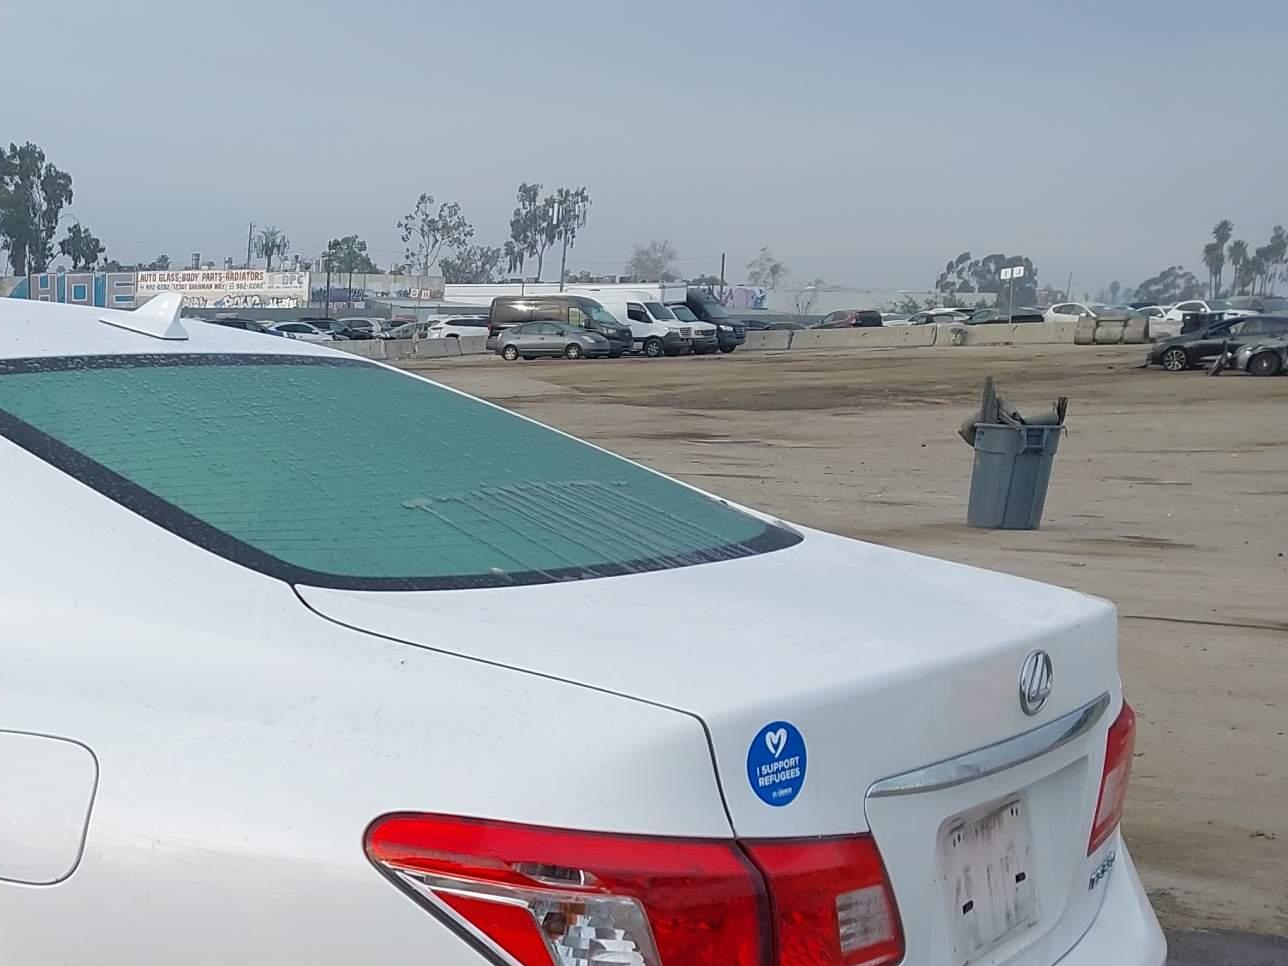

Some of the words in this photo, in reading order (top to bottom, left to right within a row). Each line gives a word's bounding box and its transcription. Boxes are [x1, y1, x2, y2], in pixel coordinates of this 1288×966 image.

[140, 272, 157, 282] AUTO
[756, 766, 760, 777] I
[761, 756, 800, 775] SUPPORT
[758, 767, 800, 788] REFUGEES
